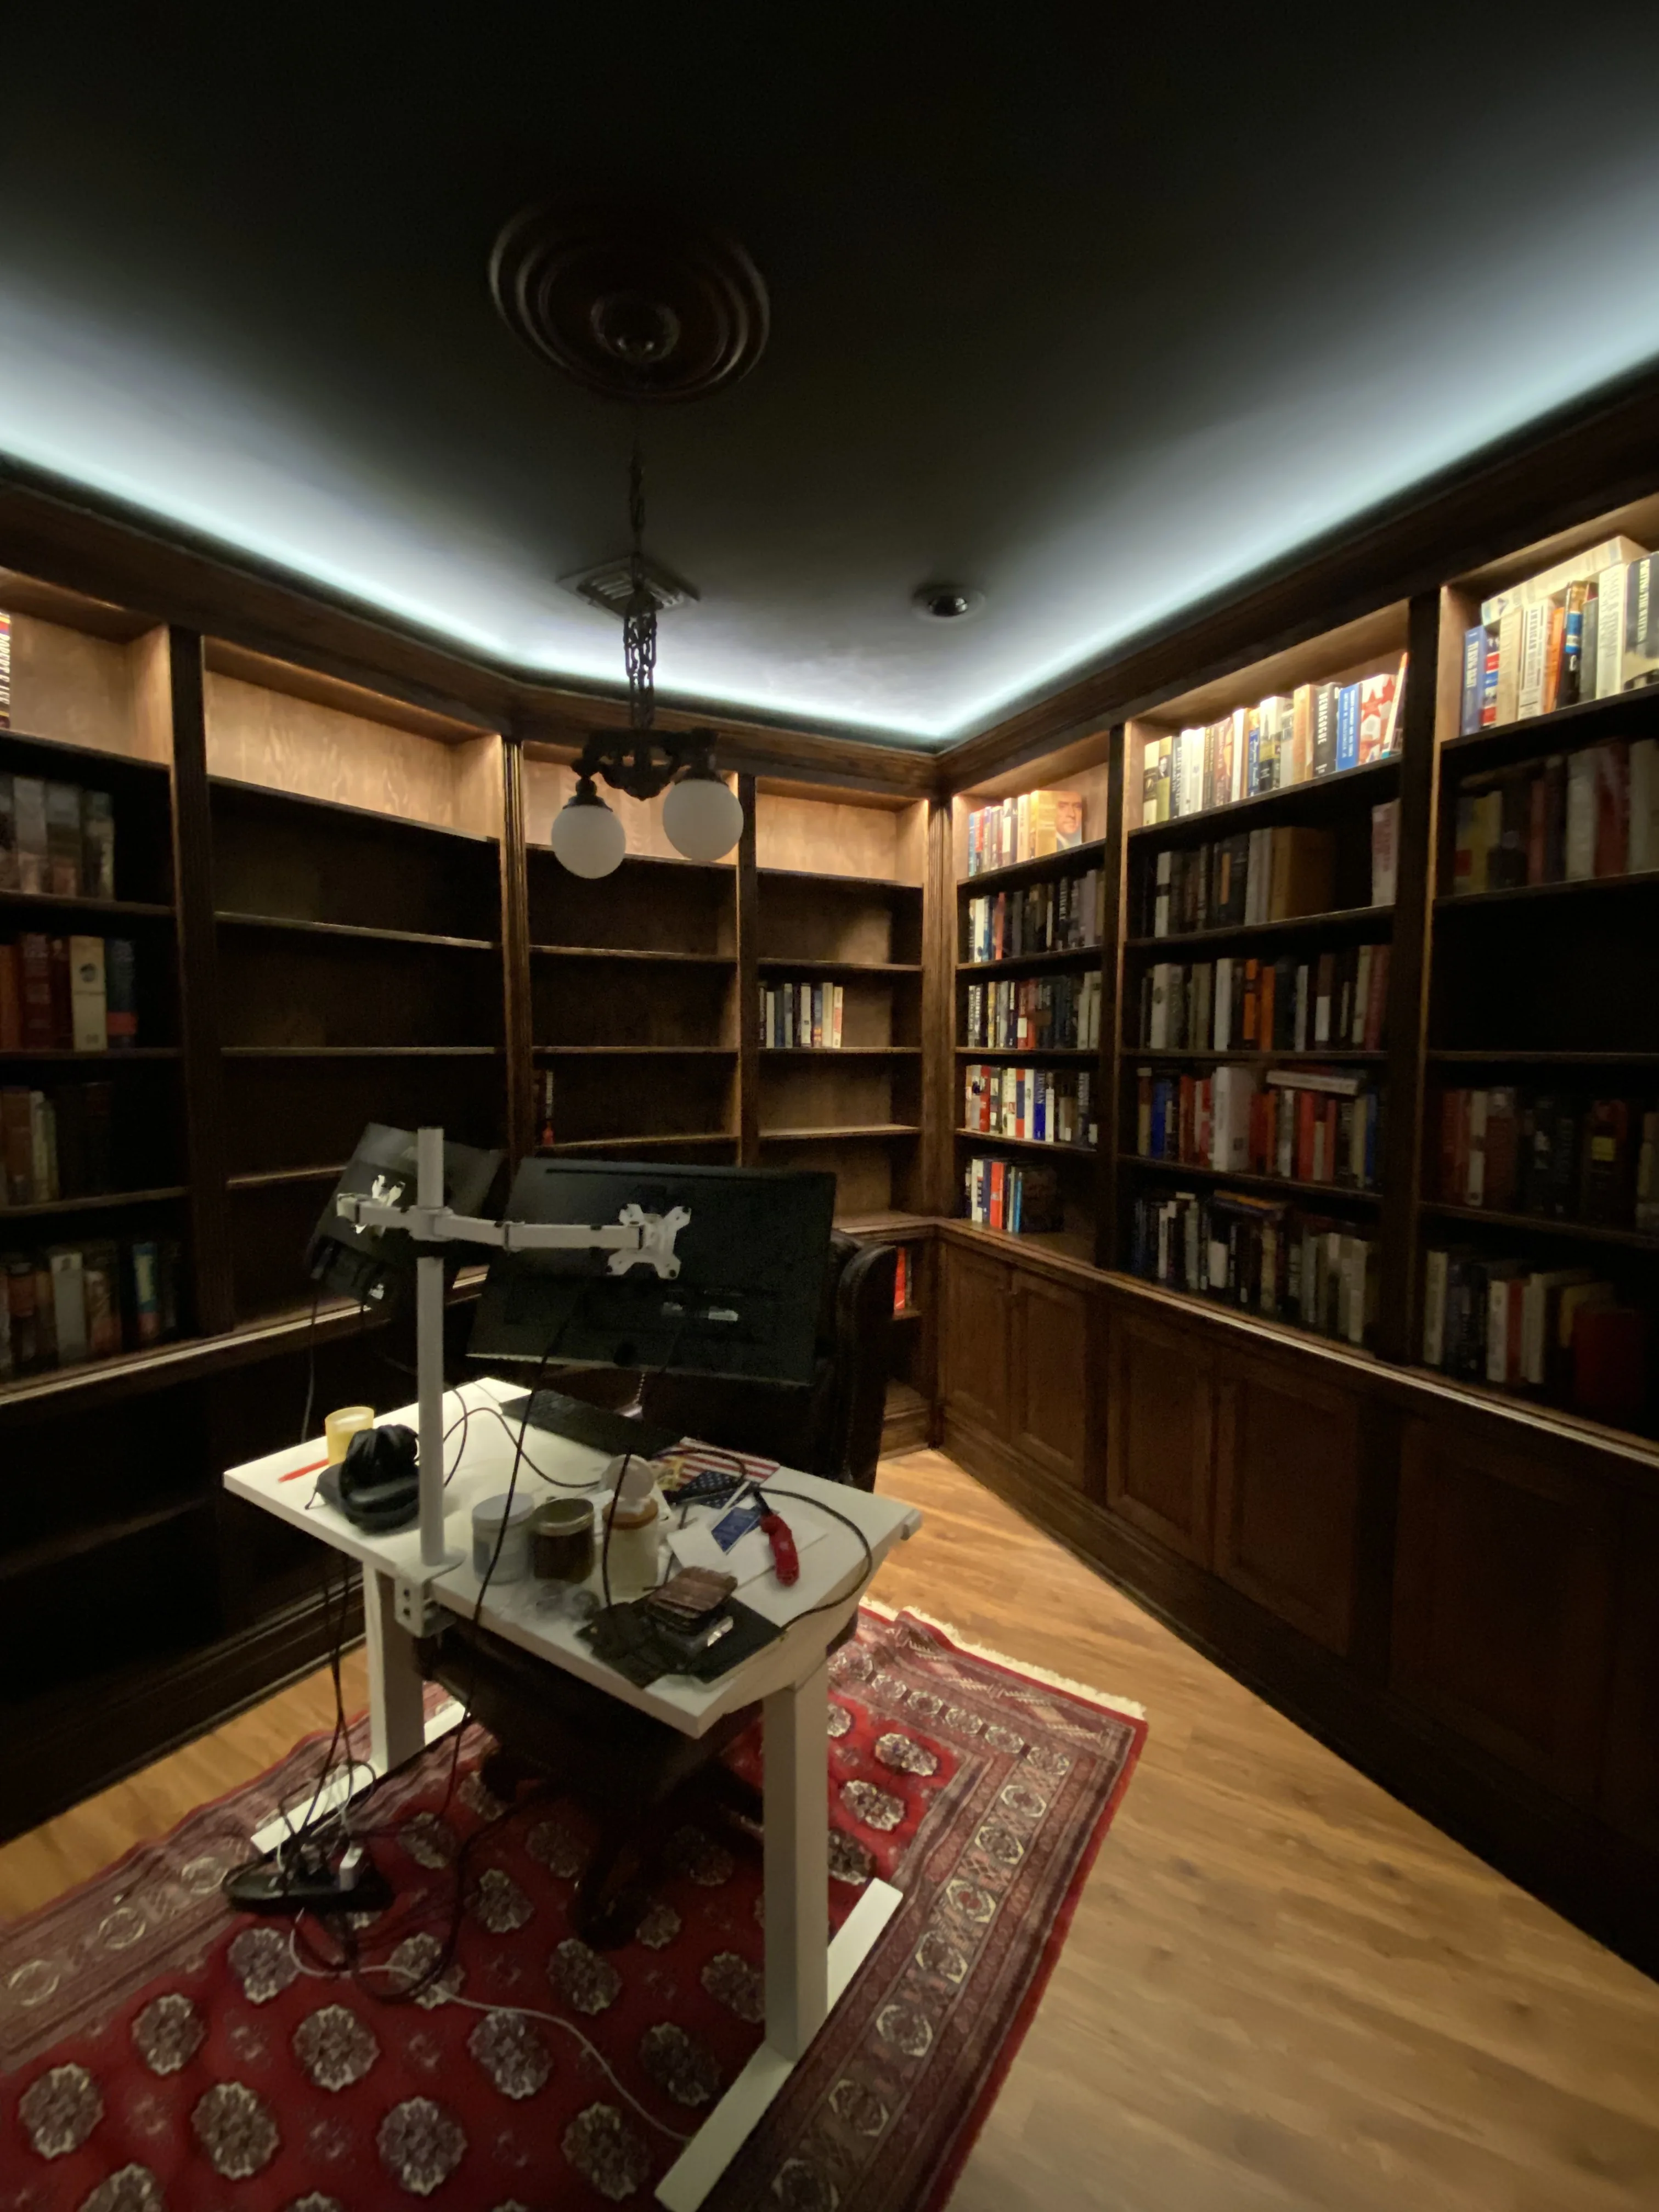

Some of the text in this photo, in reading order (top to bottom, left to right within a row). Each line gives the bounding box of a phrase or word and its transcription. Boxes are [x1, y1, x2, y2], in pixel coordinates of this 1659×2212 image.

[1528, 609, 1538, 650] AMERICAN
[1318, 692, 1328, 745] DEMAGOGUE
[1037, 1073, 1046, 1104] TRUMAN
